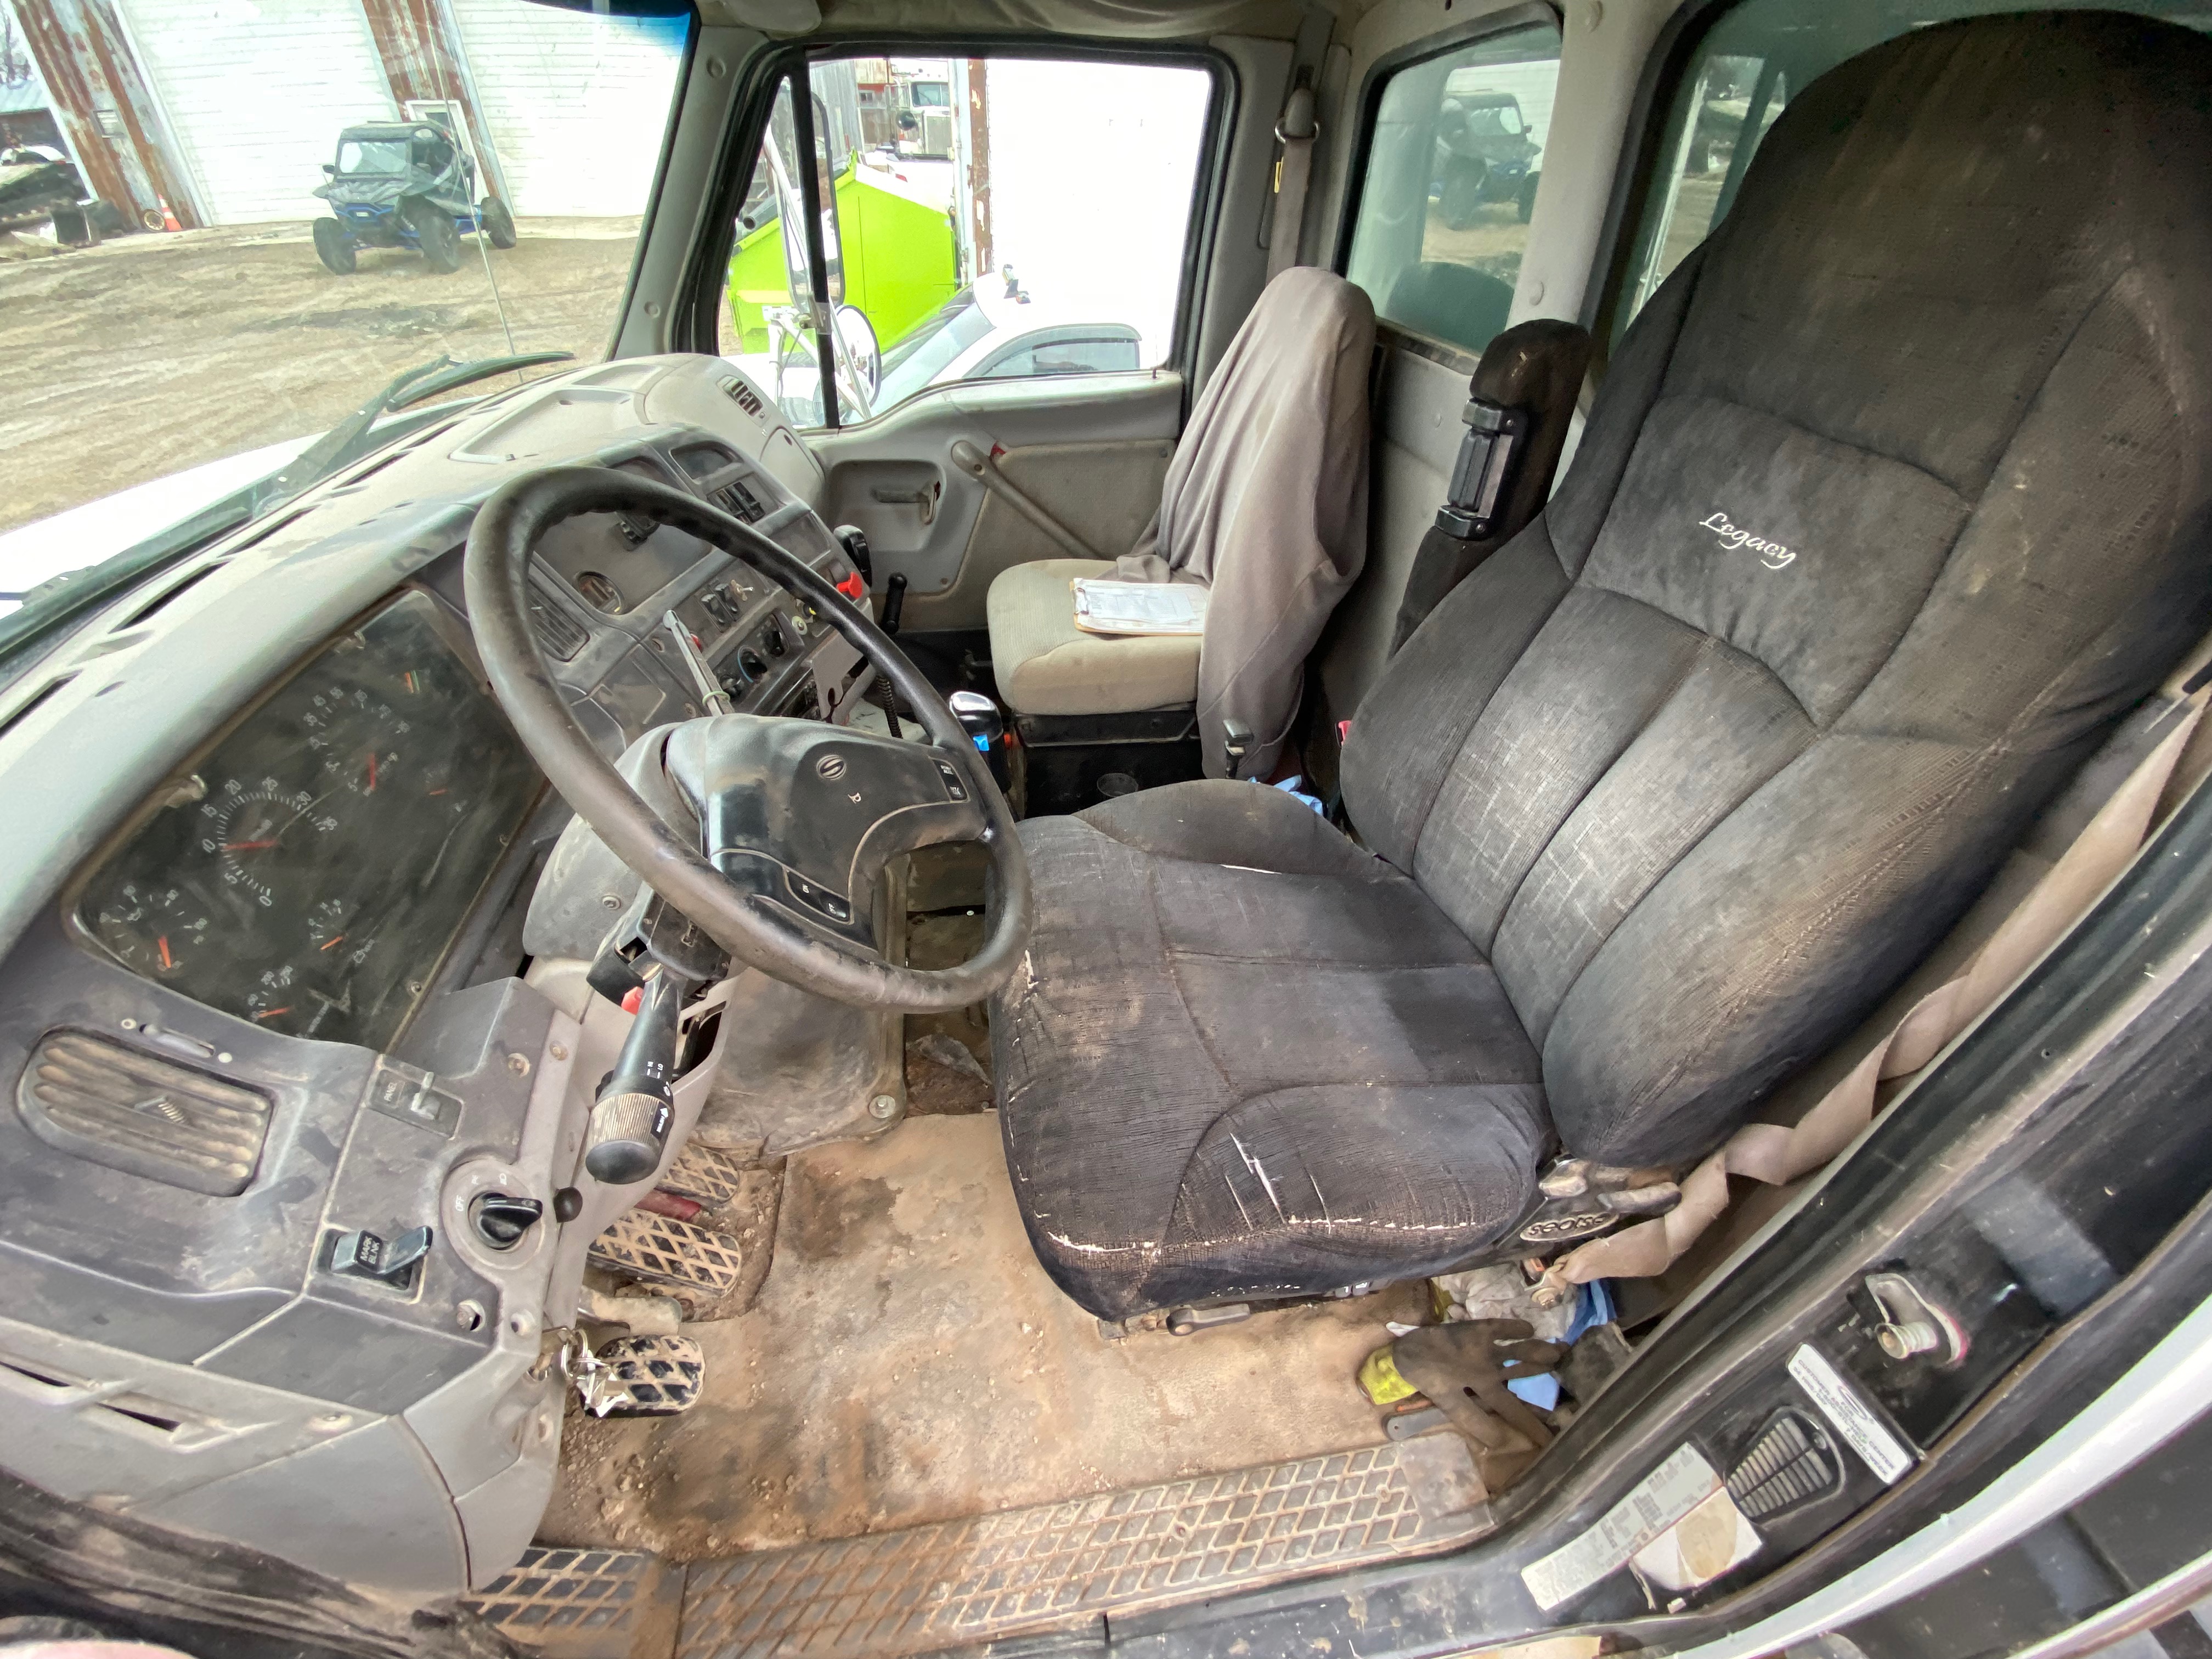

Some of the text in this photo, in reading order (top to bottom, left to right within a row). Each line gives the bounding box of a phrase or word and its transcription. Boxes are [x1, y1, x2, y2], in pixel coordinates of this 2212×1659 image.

[1699, 512, 1797, 569] Legacy
[225, 780, 241, 794] 20
[262, 776, 278, 791] 25
[297, 791, 311, 805] 30
[201, 804, 217, 817] 15
[202, 839, 216, 853] 10
[224, 873, 237, 884] 5
[259, 896, 272, 906] 0
[384, 1082, 398, 1102] PANEL
[656, 1115, 665, 1133] WASH
[455, 1195, 465, 1212] OFF
[360, 1235, 373, 1261] MARK
[368, 1240, 380, 1265] BLNK
[1797, 1358, 1830, 1395] CUSTOMER
[1868, 1440, 1895, 1469] CENTER
[1850, 1434, 1888, 1476] DAYS/WEEK
